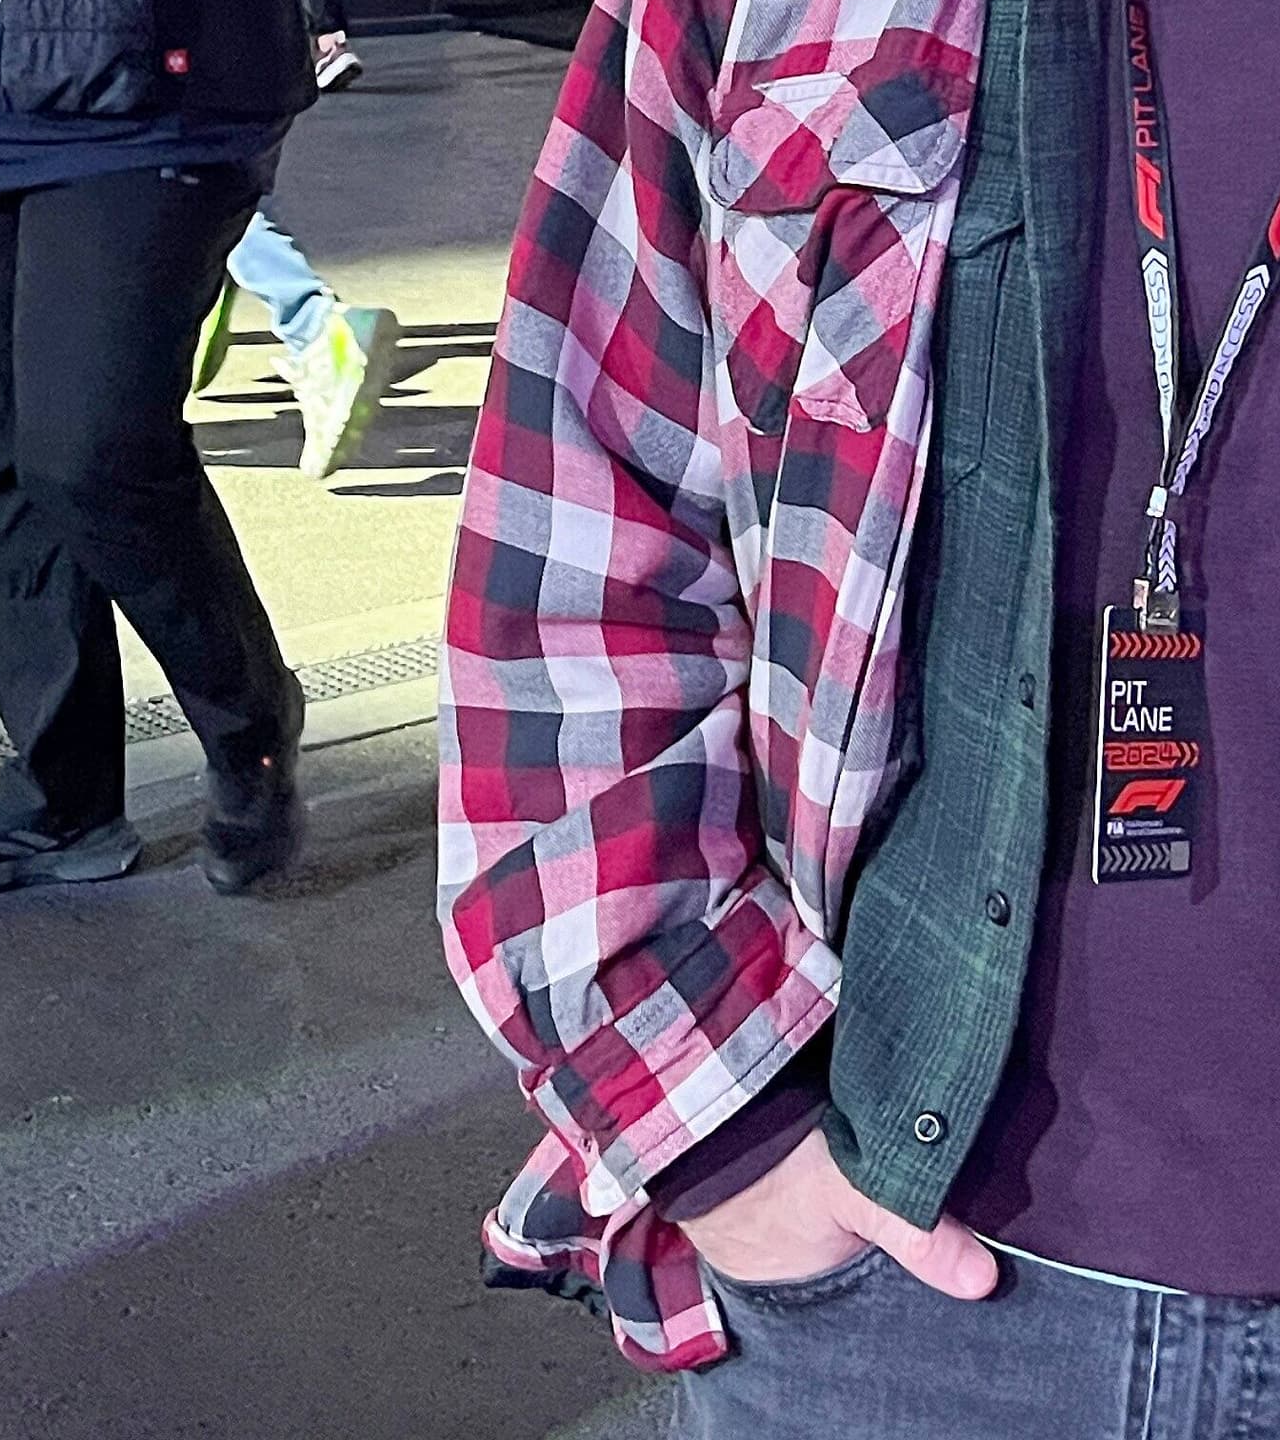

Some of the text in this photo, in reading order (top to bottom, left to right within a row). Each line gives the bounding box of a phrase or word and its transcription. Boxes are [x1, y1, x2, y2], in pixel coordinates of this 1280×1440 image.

[1129, 5, 1153, 93] LANE
[1134, 97, 1159, 148] PIT
[1147, 269, 1169, 368] ACCESS
[1214, 286, 1261, 377] ACCESS
[1111, 679, 1148, 706] PIT
[1110, 707, 1173, 733] LANE
[1108, 741, 1177, 768] 2024
